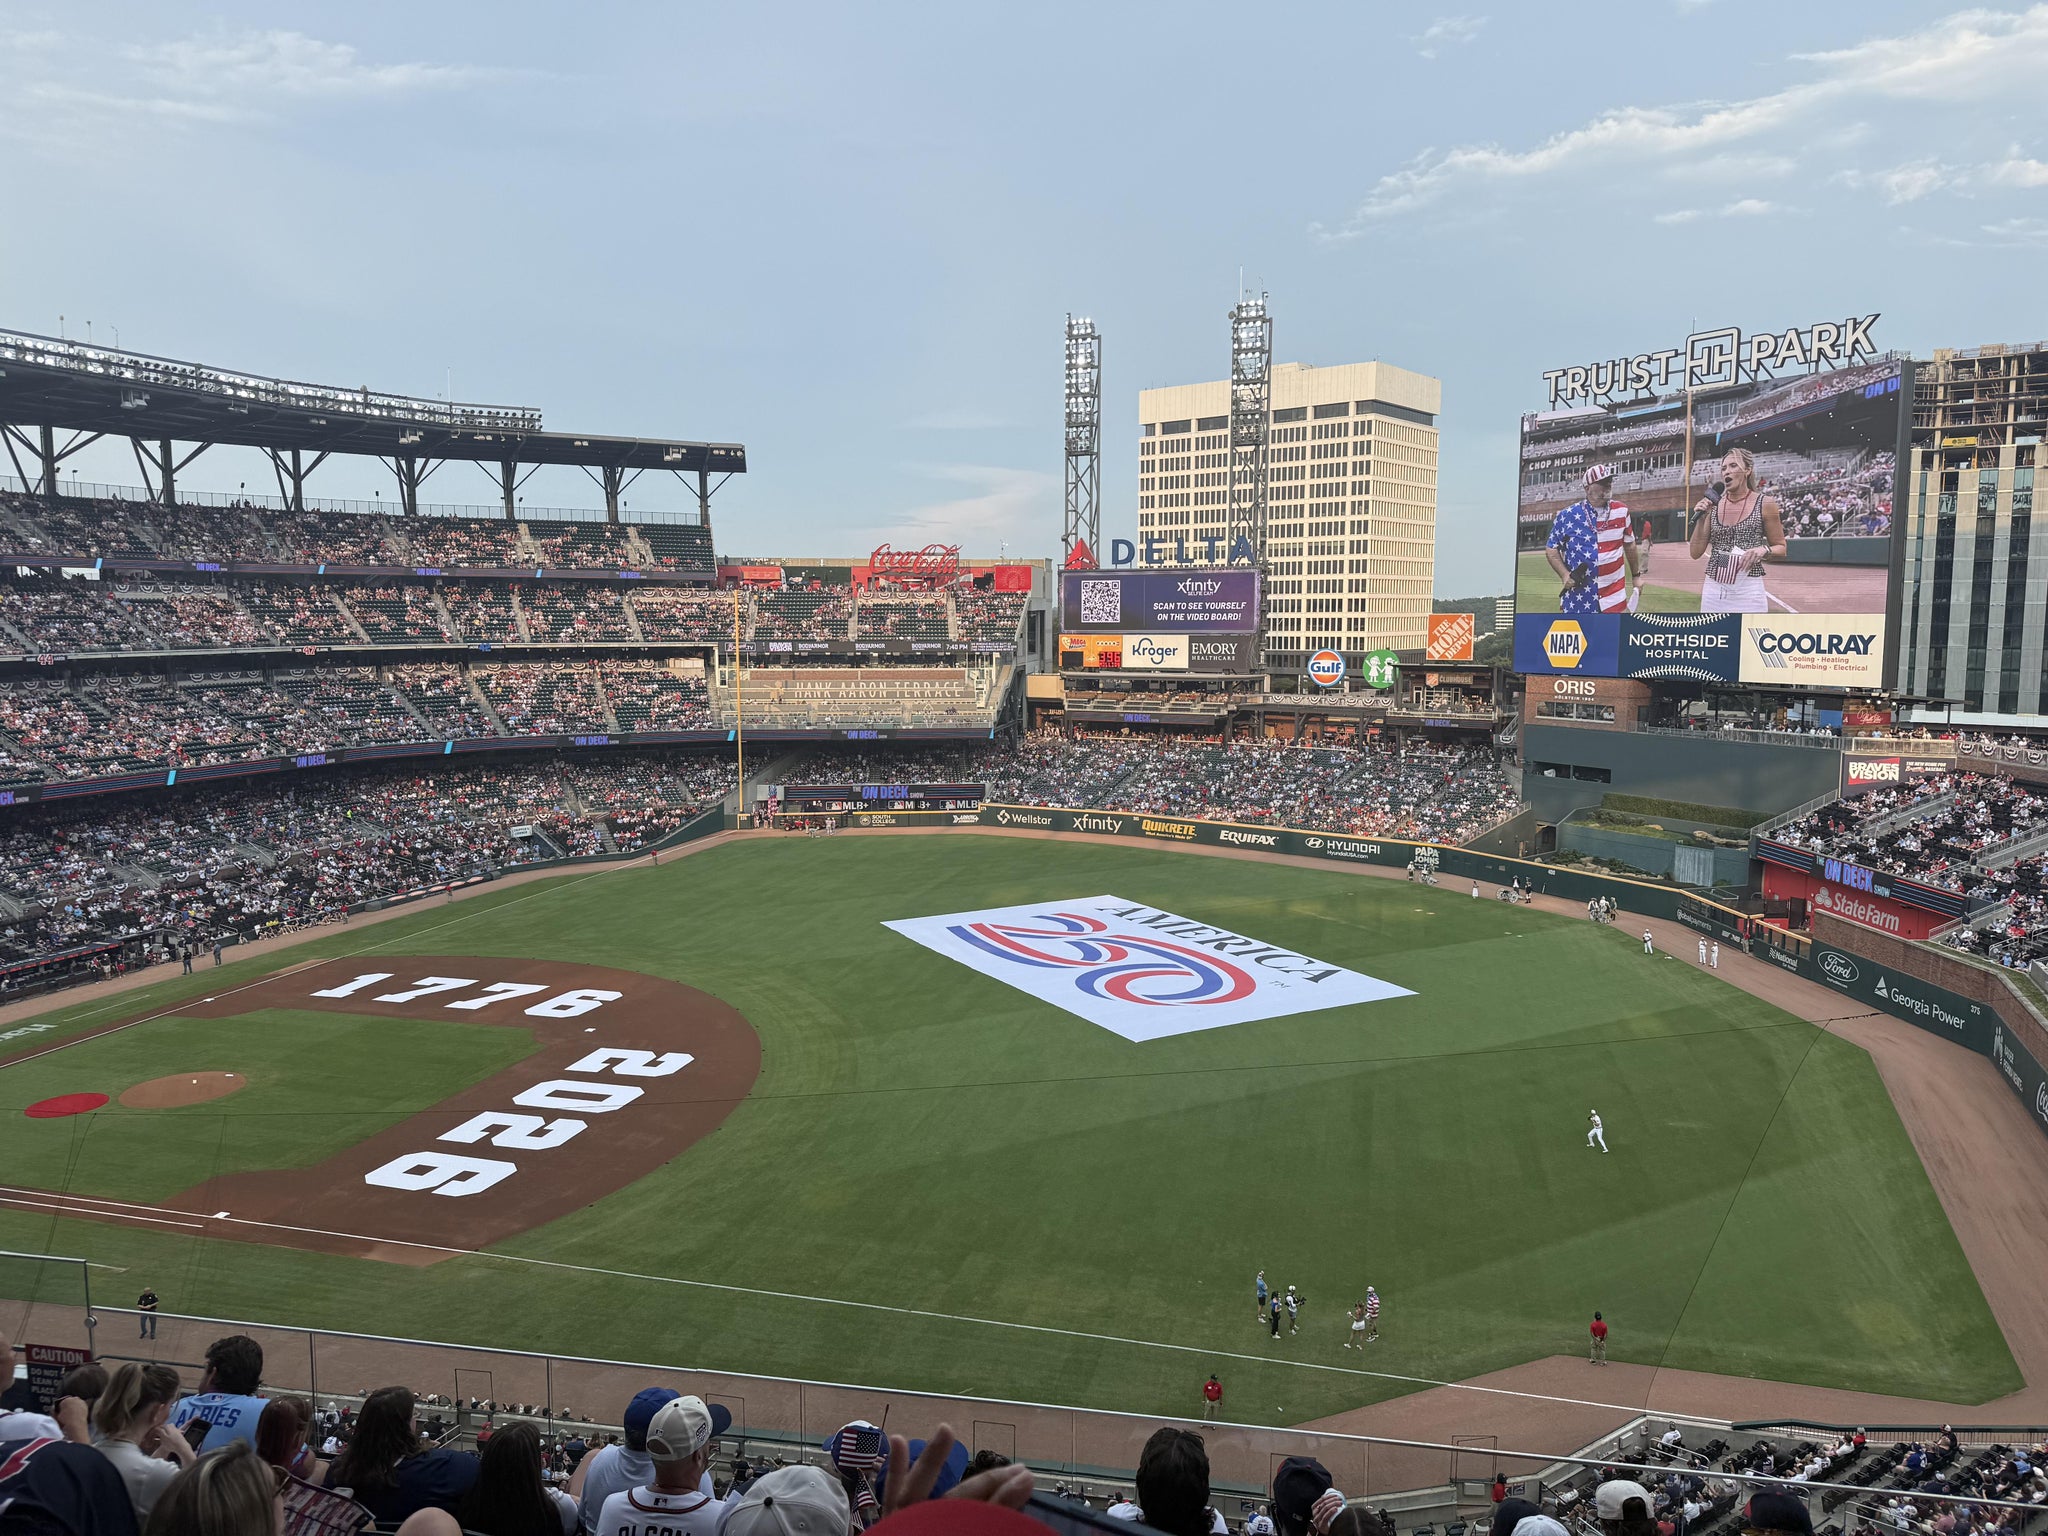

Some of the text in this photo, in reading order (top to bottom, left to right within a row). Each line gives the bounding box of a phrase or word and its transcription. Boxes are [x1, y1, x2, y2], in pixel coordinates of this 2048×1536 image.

[1543, 313, 1881, 404] TRUIST PARK
[1864, 381, 1885, 399] ON
[1615, 447, 1634, 456] MADE
[1529, 454, 1585, 471] CHOP HOUSE
[1111, 535, 1255, 566] DELTA
[1177, 578, 1222, 595] xfinity
[1153, 602, 1175, 610] SCAN
[1176, 602, 1187, 610] TO
[1205, 601, 1247, 609] YOURSELF
[1157, 613, 1241, 621] ON THE VIDEO BOARD!
[1432, 618, 1452, 637] THE
[1428, 614, 1473, 660] HOME
[1443, 630, 1473, 659] DEPOT
[1550, 633, 1580, 654] NAPA
[1629, 633, 1729, 648] NORTHSIDE
[1759, 633, 1877, 655] COOLRAY
[1132, 637, 1178, 665] Kroger
[1192, 642, 1238, 655] EMORY
[1645, 649, 1709, 660] HOSPITAL
[1099, 652, 1121, 663] 396
[1788, 655, 1850, 665] Cooling Heating
[1310, 661, 1342, 674] Gulf
[1794, 663, 1868, 672] Plumbing Electrical
[794, 682, 961, 698] HANK AARON TERRACE
[1554, 679, 1596, 696] ORIS
[575, 736, 587, 746] ON
[588, 735, 609, 746] DECK
[847, 730, 858, 739] ON
[860, 730, 878, 739] DECK
[1848, 761, 1900, 772] BRAVES
[1848, 769, 1900, 781] VISION
[862, 786, 878, 799] ON
[880, 785, 909, 799] DECK
[843, 802, 869, 810] MLB+
[1011, 813, 1052, 825] Wellstar
[1072, 813, 1123, 834] xfinity
[1142, 819, 1197, 836] QUIKRETE
[1219, 829, 1277, 846] EQUIFAX
[1327, 840, 1381, 854] HYUNDAI
[1414, 846, 1439, 857] PAPA
[1413, 854, 1440, 865] JOHNS
[1824, 858, 1843, 882] ON
[1842, 861, 1875, 894] DECK
[1873, 884, 1891, 898] SHOW
[1096, 904, 1343, 984] AMERICA
[1824, 953, 1852, 980] Ford
[309, 972, 624, 1019] 1776
[1890, 986, 1966, 1030] Georgia Power
[1970, 1004, 1981, 1016] 375
[364, 1046, 695, 1198] 2026
[31, 1347, 84, 1365] CAUTION
[30, 1367, 59, 1377] DO NOT
[32, 1377, 52, 1386] LEAN
[31, 1386, 55, 1394] PLACE
[175, 1404, 242, 1428] ALBIES
[1257, 1523, 1269, 1533] 23
